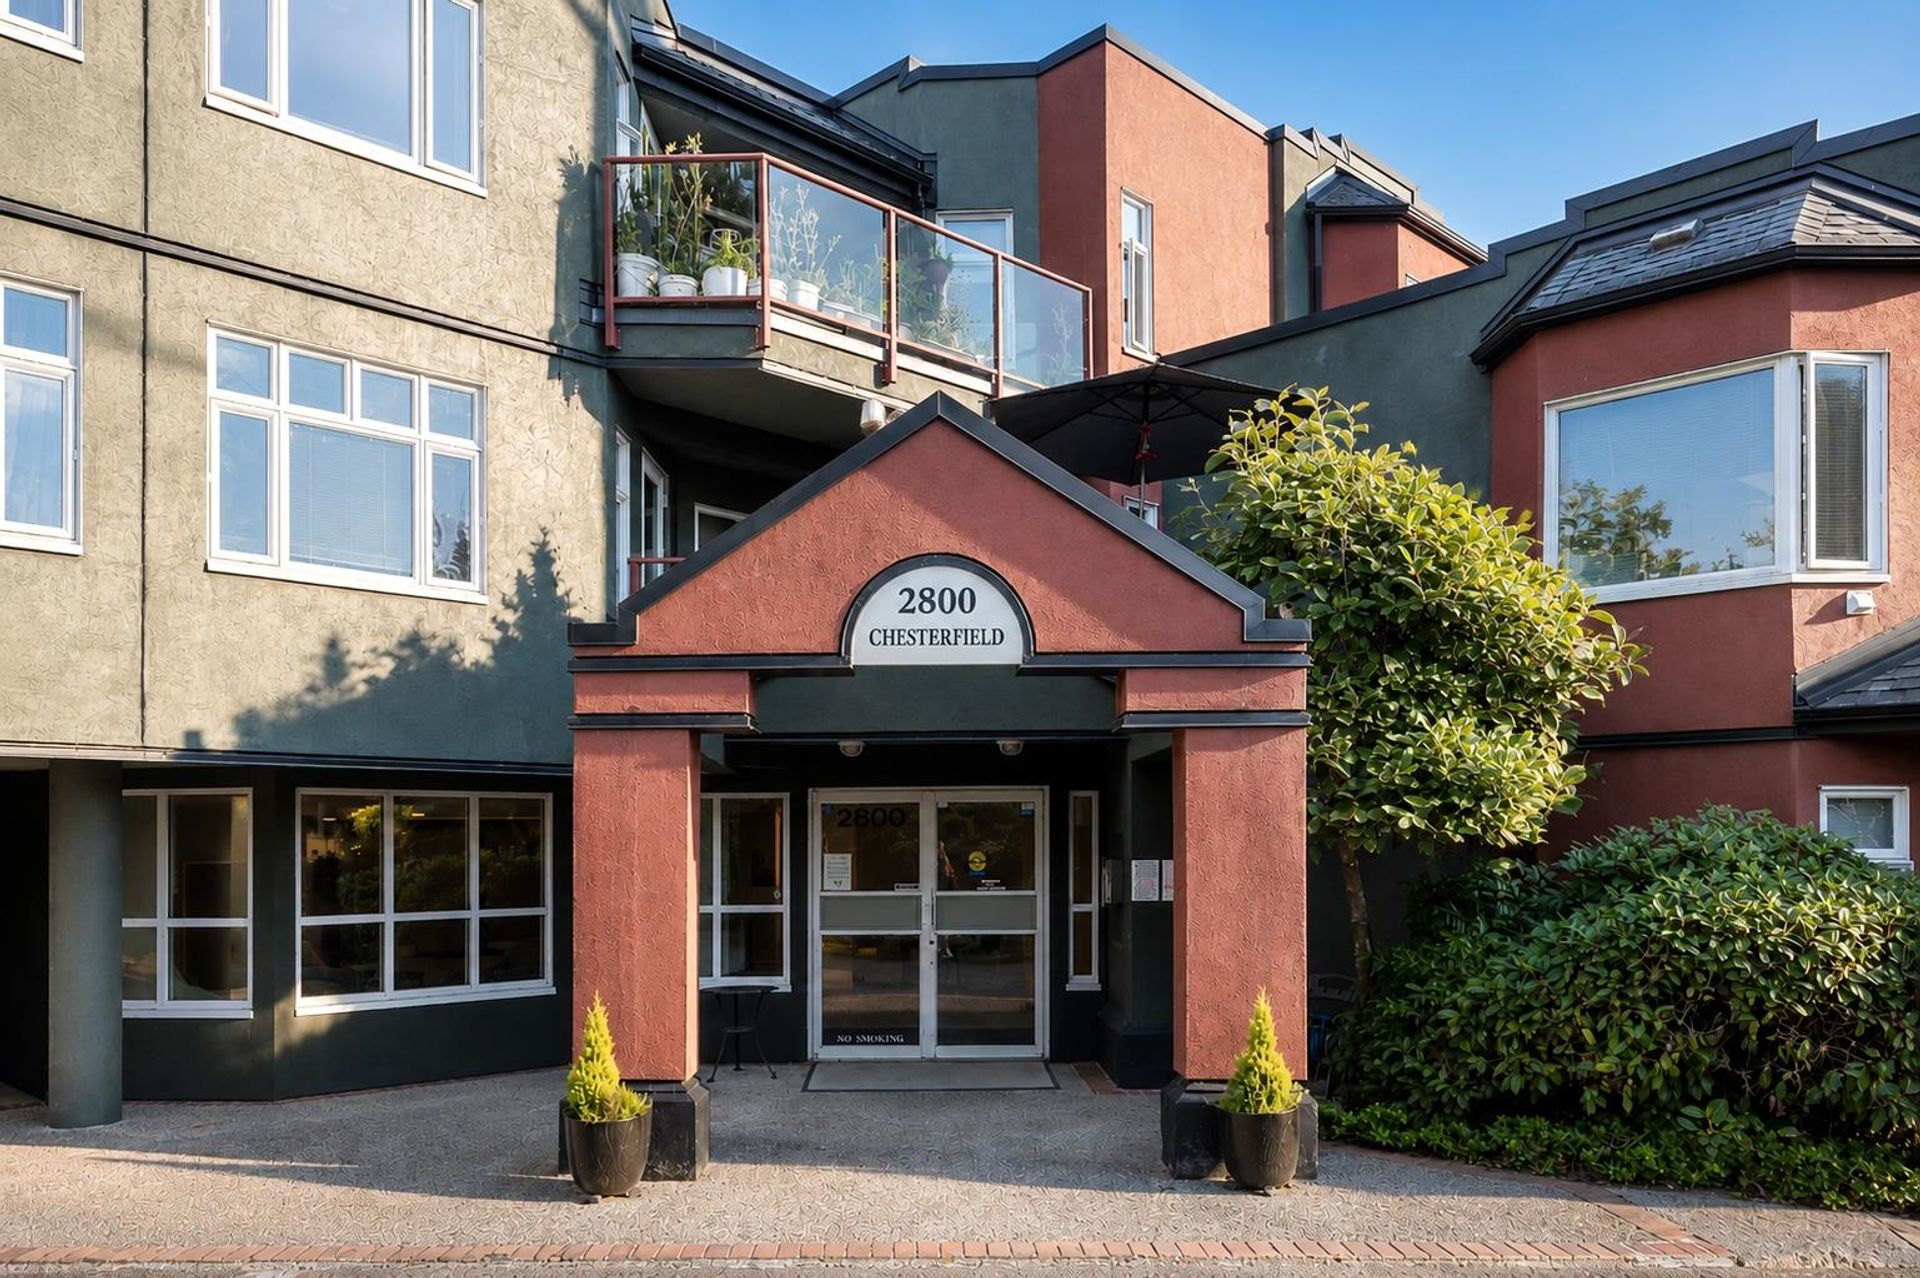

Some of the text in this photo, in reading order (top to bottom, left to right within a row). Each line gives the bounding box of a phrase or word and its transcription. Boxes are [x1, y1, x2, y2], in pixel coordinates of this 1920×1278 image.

[898, 587, 976, 614] 2800
[869, 627, 1005, 646] CHESTERFIELD
[837, 807, 905, 828] 2800
[837, 1034, 904, 1043] NO SMOKING
